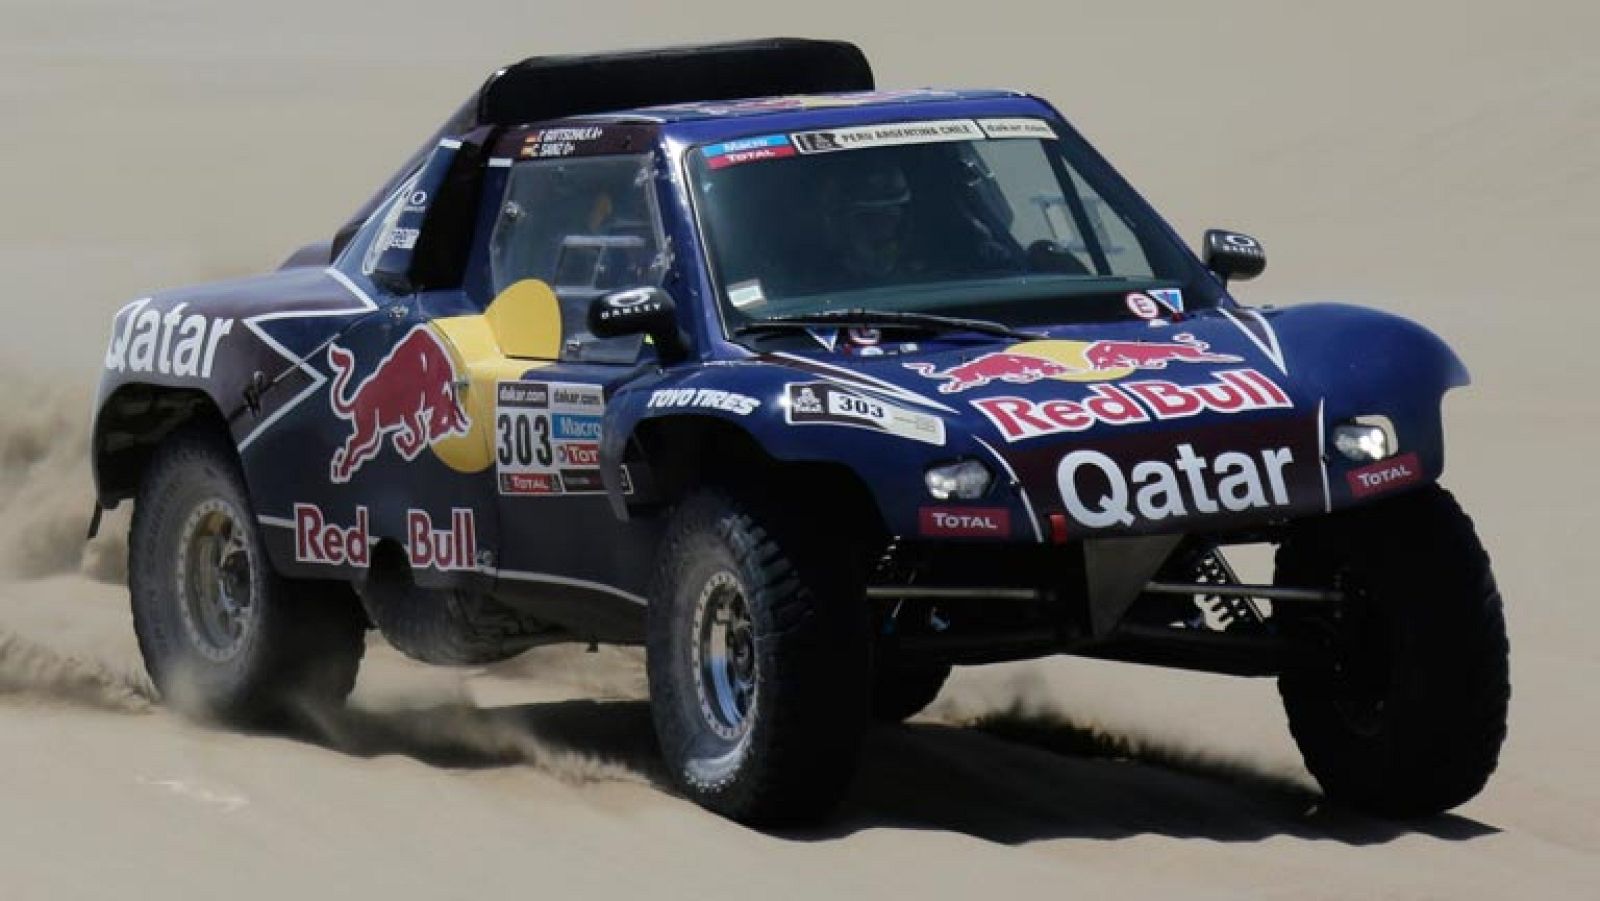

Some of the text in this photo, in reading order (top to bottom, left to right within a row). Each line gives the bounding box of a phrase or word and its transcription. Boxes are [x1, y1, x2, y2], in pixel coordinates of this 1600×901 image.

[726, 149, 776, 163] TOTAL
[647, 388, 761, 416] TOYO TIRES
[838, 394, 885, 419] 303
[970, 368, 1294, 443] Red Bull
[497, 413, 553, 467] 303
[568, 444, 600, 463] TOT
[1056, 443, 1295, 530] Qatar
[1357, 463, 1414, 489] TOTAL
[931, 511, 999, 530] TOTAL
[293, 502, 478, 572] Red Bull
